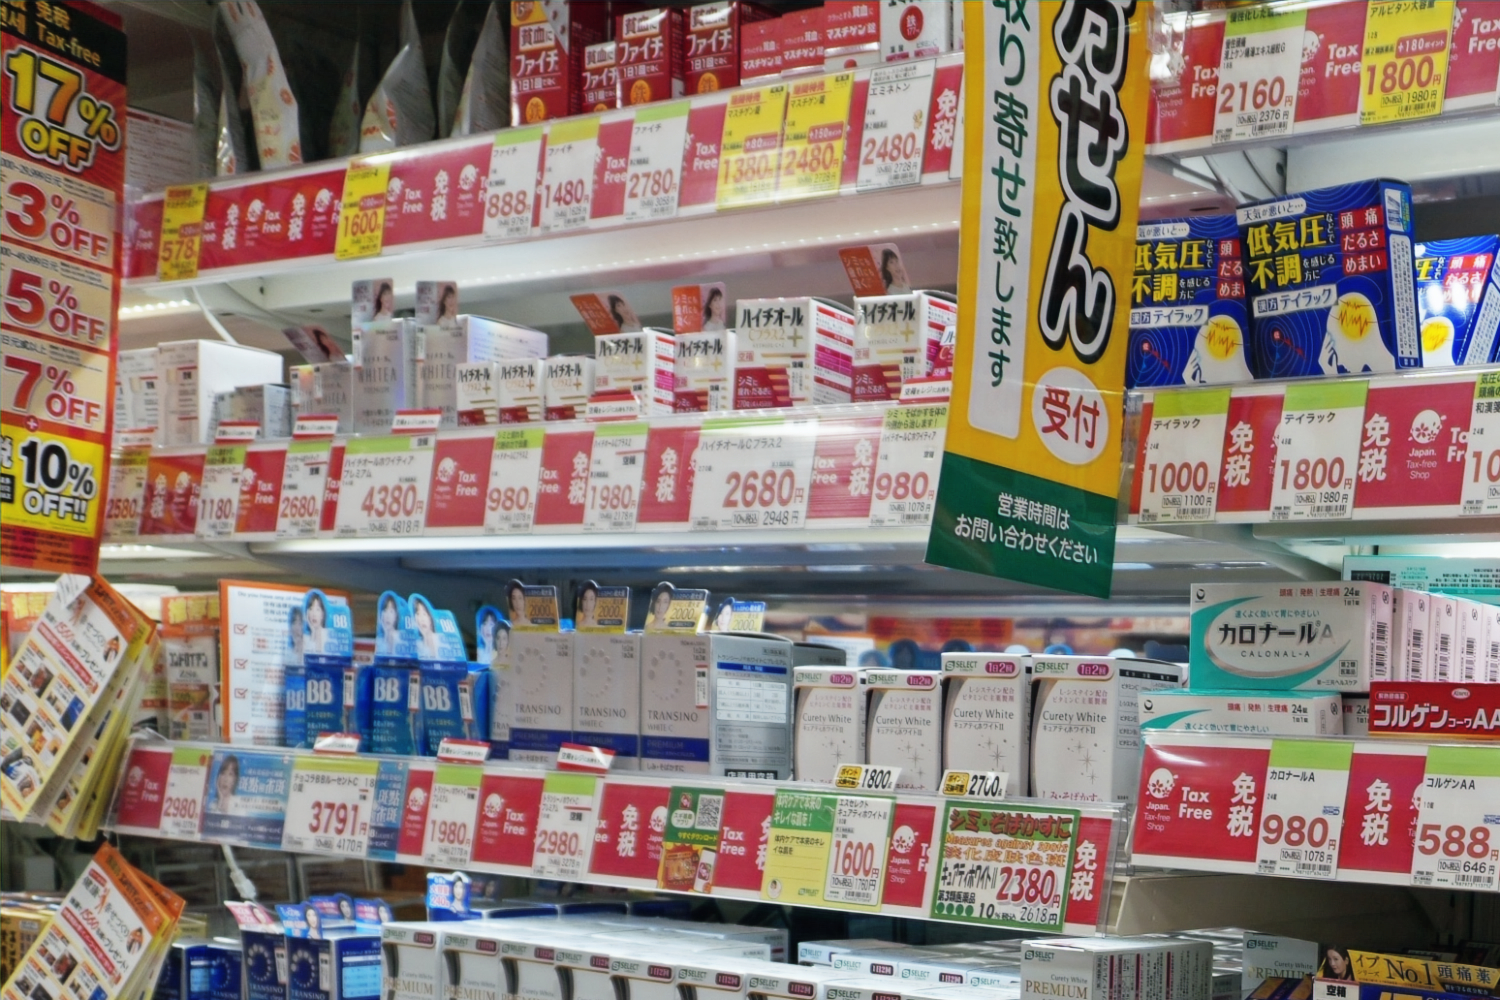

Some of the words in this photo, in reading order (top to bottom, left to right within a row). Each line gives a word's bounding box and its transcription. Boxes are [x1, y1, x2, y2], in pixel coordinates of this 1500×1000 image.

[515, 46, 559, 77] ファイチ
[619, 38, 664, 61] ファイチ
[1328, 44, 1358, 59] Tax
[1325, 61, 1361, 77] Free
[18, 113, 94, 171] OFF
[49, 220, 108, 260] OFF
[1246, 212, 1326, 258] 低気圧
[1250, 255, 1302, 290] 不調
[48, 302, 105, 344] OFF
[741, 306, 804, 328] ハイチオール
[46, 397, 100, 425] OFF
[1042, 385, 1100, 449] 受付
[1284, 411, 1336, 425] テイラック
[1359, 413, 1391, 482] 免税
[1408, 448, 1436, 458] Japan.
[849, 438, 874, 496] 免税
[1406, 459, 1438, 469] Tax-free
[1409, 469, 1430, 480] Shop
[998, 492, 1070, 531] 営業時間は
[954, 513, 1098, 564] お問い合わせください
[307, 678, 332, 703] BB
[1181, 787, 1209, 803] Tax
[1179, 804, 1212, 821] Free
